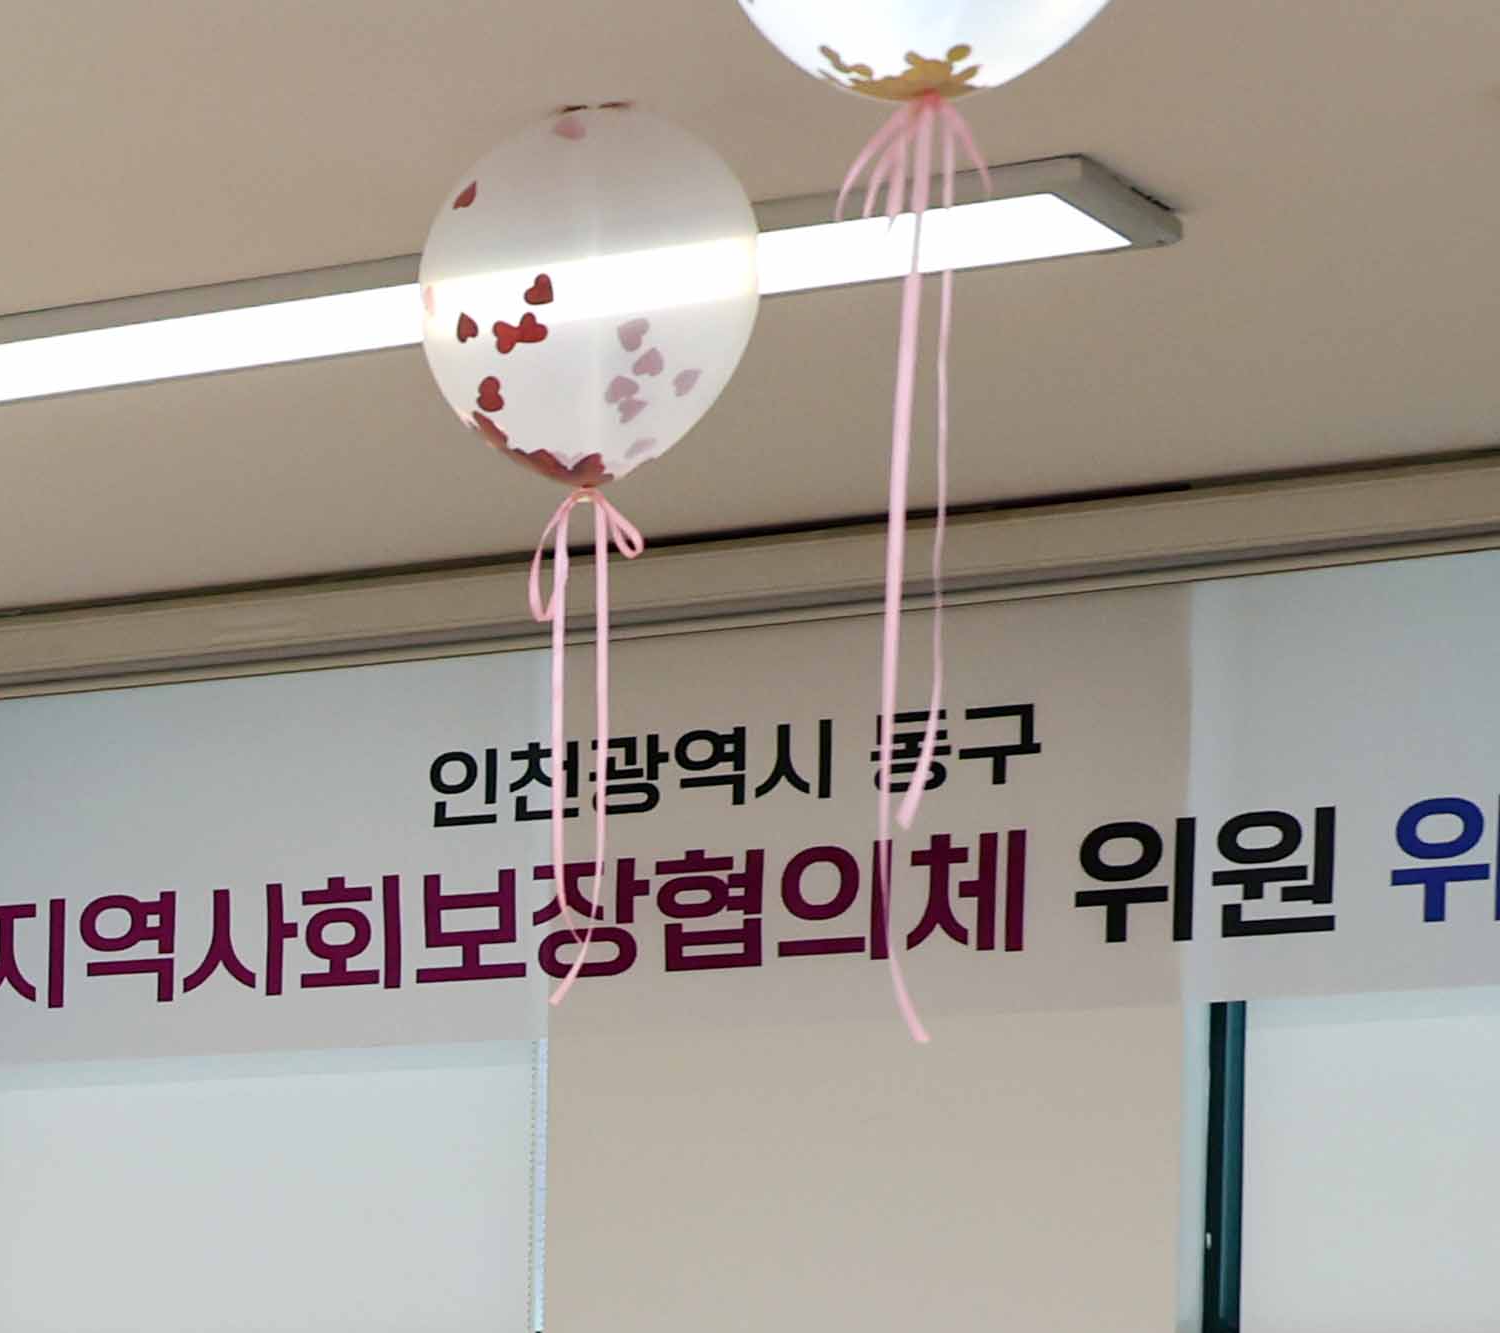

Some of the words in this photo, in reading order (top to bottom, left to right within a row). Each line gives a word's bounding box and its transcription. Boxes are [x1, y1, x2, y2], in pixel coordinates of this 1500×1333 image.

[428, 719, 833, 828] 인천광역시
[871, 703, 1041, 793] 동구
[1075, 806, 1336, 943] 위원
